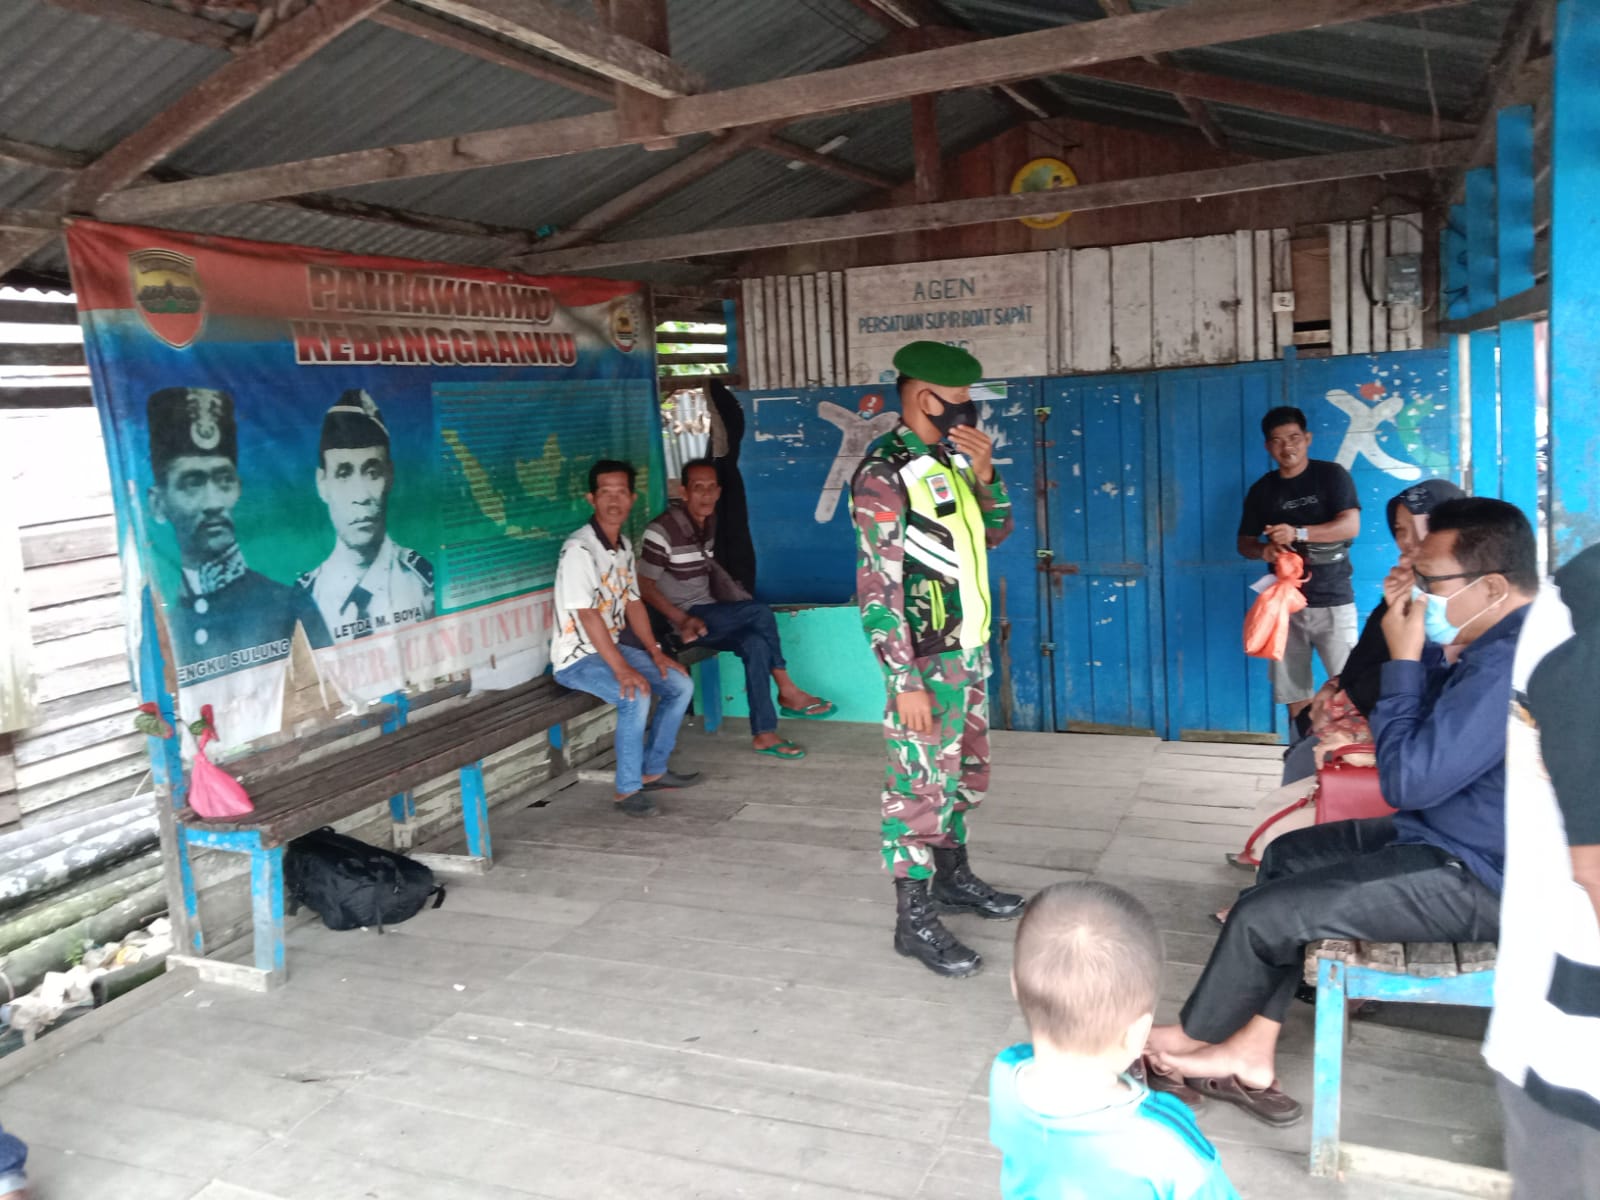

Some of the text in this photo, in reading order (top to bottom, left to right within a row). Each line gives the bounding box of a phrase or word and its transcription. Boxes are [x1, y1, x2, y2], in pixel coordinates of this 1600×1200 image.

[306, 263, 555, 325] PAHLAWANKU
[913, 277, 976, 301] AGEN
[858, 304, 1033, 335] PERSATUAN SUPIR BOAT SAPAT
[292, 320, 578, 367] KEBANGGAANKU
[333, 606, 422, 639] LETDA M. BOYA
[230, 638, 290, 668] SULUNG
